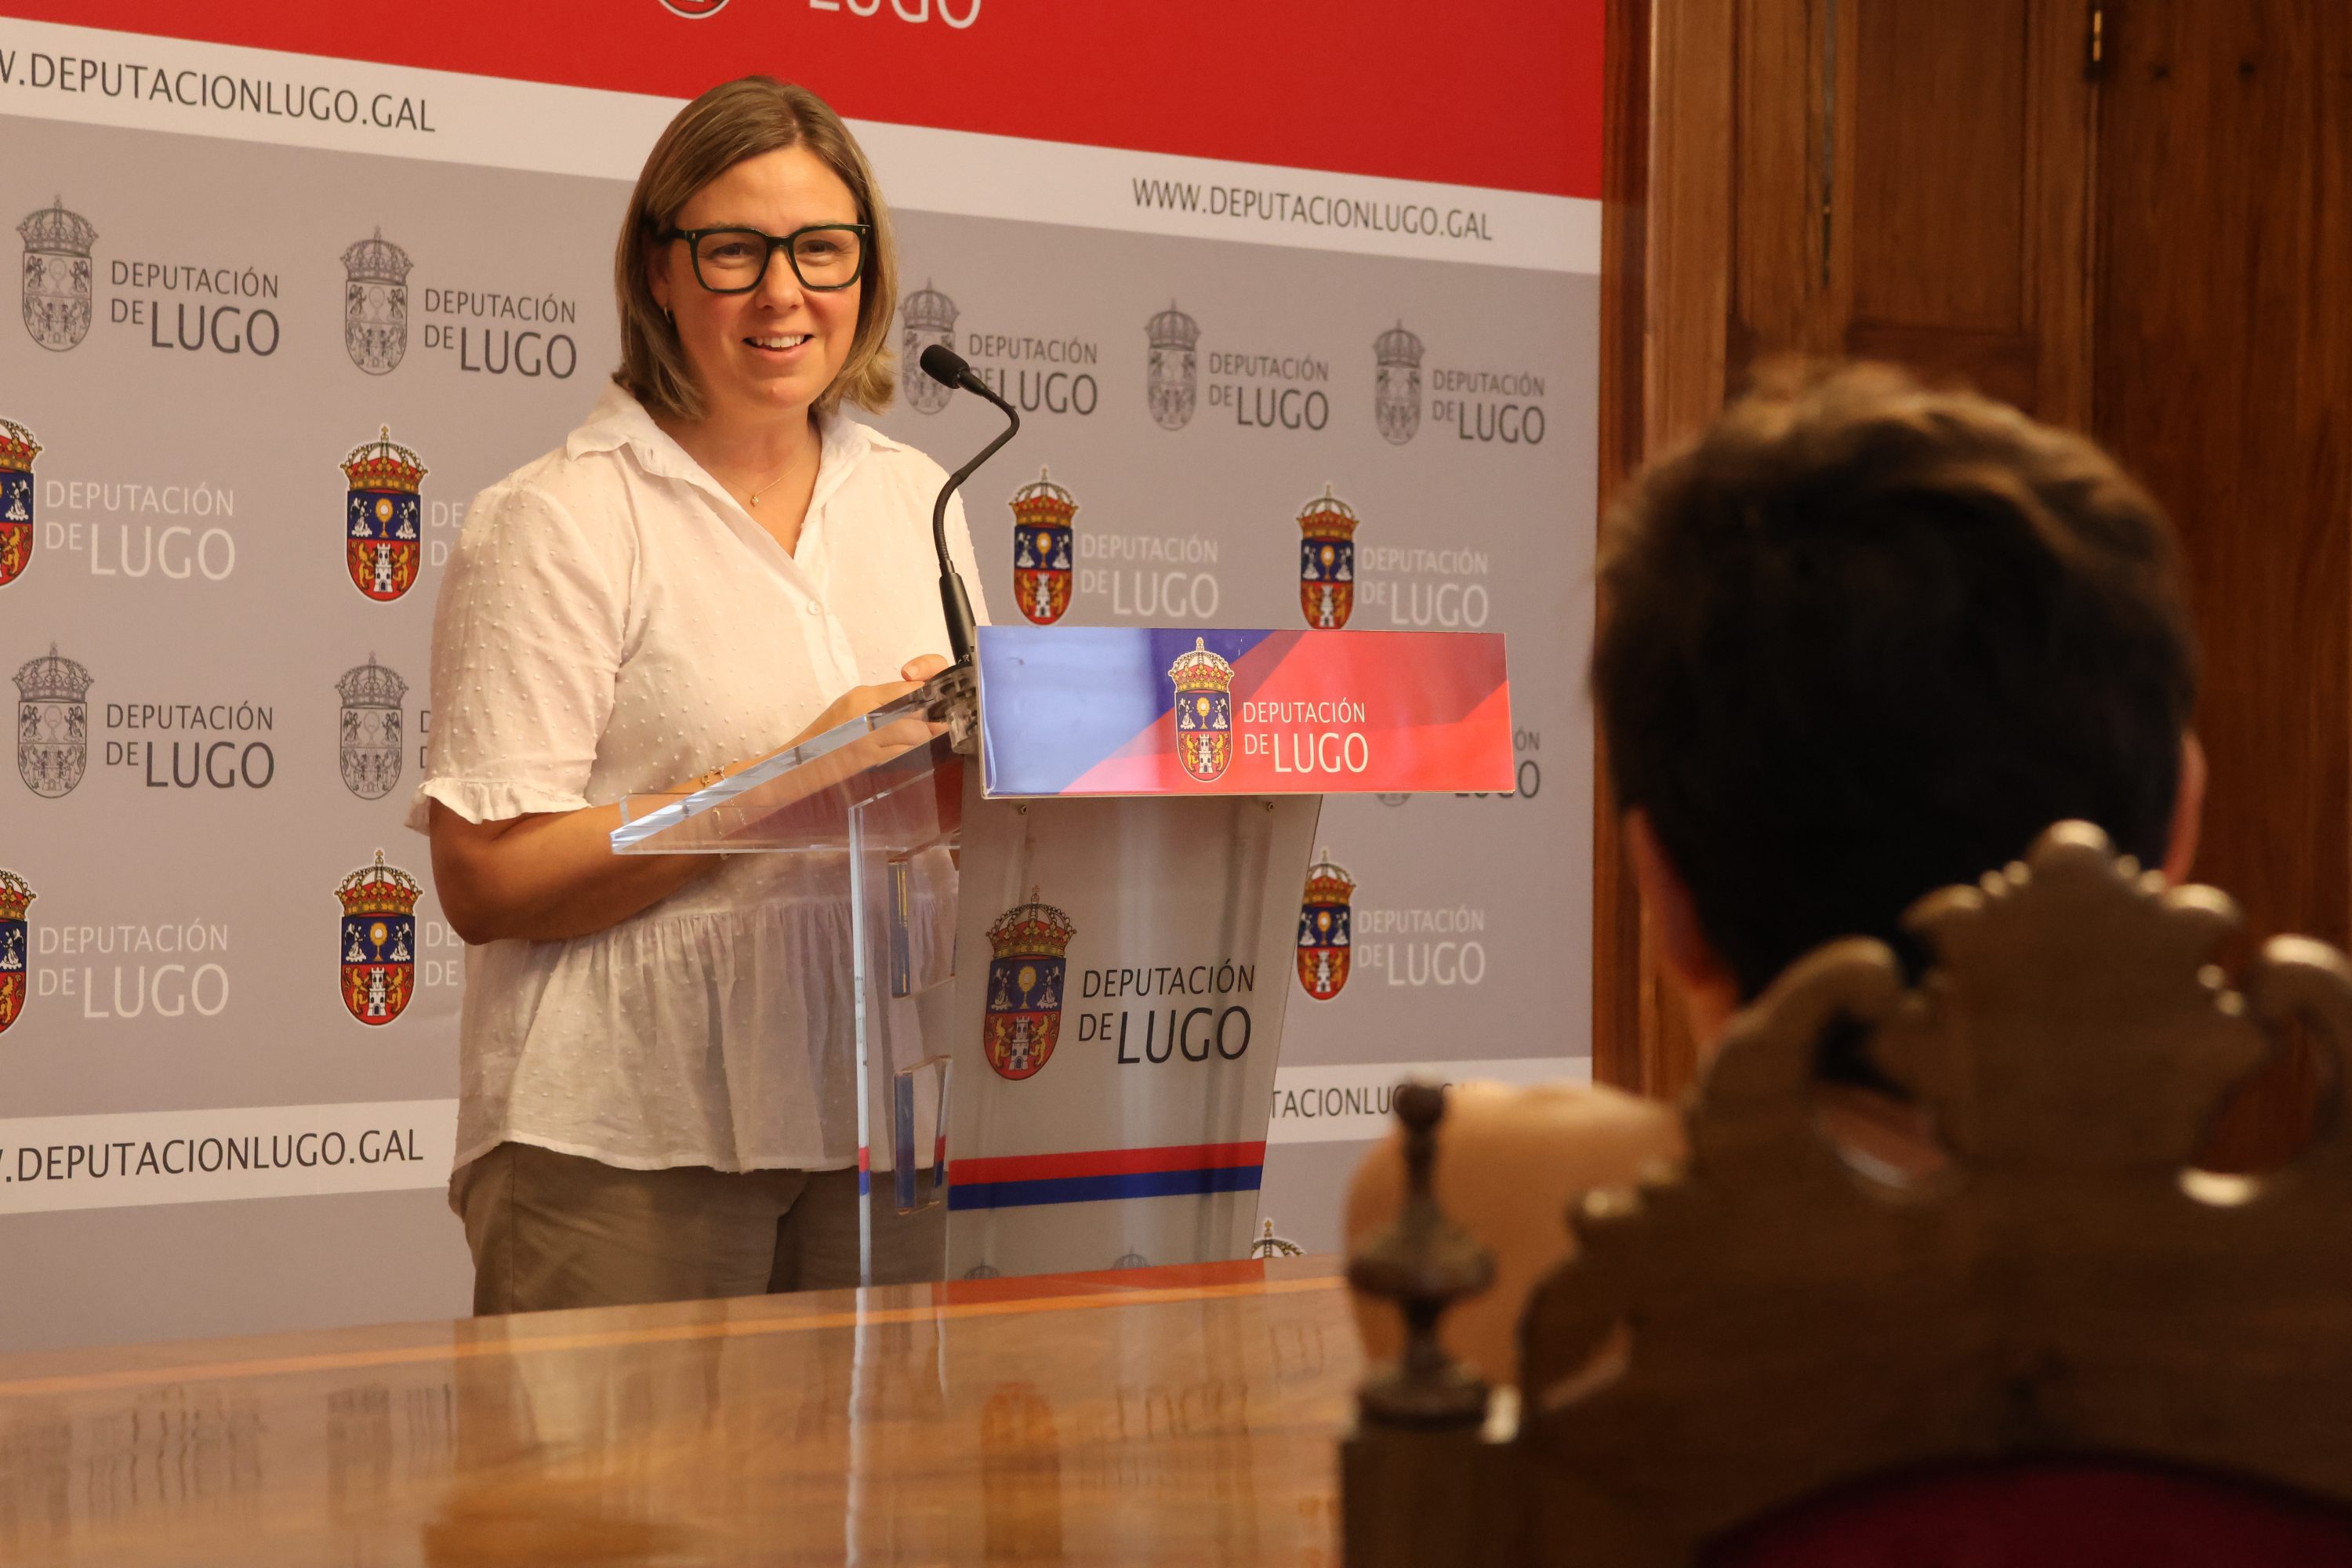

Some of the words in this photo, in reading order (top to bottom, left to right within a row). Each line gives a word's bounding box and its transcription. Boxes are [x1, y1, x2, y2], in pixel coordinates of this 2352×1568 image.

[1133, 178, 1492, 241] WWW.DEPUTACIONLUGO.GAL
[112, 260, 278, 298] DEPUTACIÓN
[425, 289, 575, 324] DEPUTACIÓN
[111, 299, 143, 325] DE
[152, 301, 279, 356] LUGO
[425, 325, 453, 349] DE
[461, 327, 576, 379] LUGO
[970, 334, 1097, 364] DEPUTACIÓN
[1210, 352, 1328, 381] DEPUTACIÓN
[1000, 370, 1097, 415] LUGO
[1434, 369, 1544, 397] DEPUTACIÓN
[1209, 384, 1232, 407] DE
[1237, 387, 1329, 430] LUGO
[1432, 401, 1454, 422] DE
[1459, 402, 1544, 445] LUGO
[46, 481, 233, 516] DEPUTACIÓN
[45, 522, 82, 550] DE
[91, 524, 235, 580] LUGO
[1081, 533, 1218, 563] DEPUTACIÓN
[1361, 546, 1488, 575] DEPUTACIÓN
[1080, 569, 1108, 594] DE
[1113, 571, 1218, 619] LUGO
[1361, 581, 1385, 604] DE
[1392, 583, 1489, 628] LUGO
[107, 701, 272, 730] DEPUTACIÓN
[1243, 697, 1364, 723] DEPUTACIÓN
[107, 742, 138, 766] DE
[147, 742, 274, 789] LUGO
[1245, 734, 1269, 754] DE
[1274, 733, 1368, 772] LUGO
[40, 918, 227, 954] DEPUTACIÓN
[1358, 905, 1484, 934] DEPUTACIÓN
[426, 960, 458, 986] DE
[1083, 958, 1254, 997] DEPUTACIÓN
[1358, 944, 1383, 967] DE
[1388, 942, 1485, 985] LUGO
[38, 968, 75, 996] DE
[85, 964, 229, 1018] LUGO
[1079, 1013, 1113, 1041] DE
[1118, 1006, 1250, 1064] LUGO
[0, 1129, 423, 1182] .DEPUTACIONLUGO.GAL
